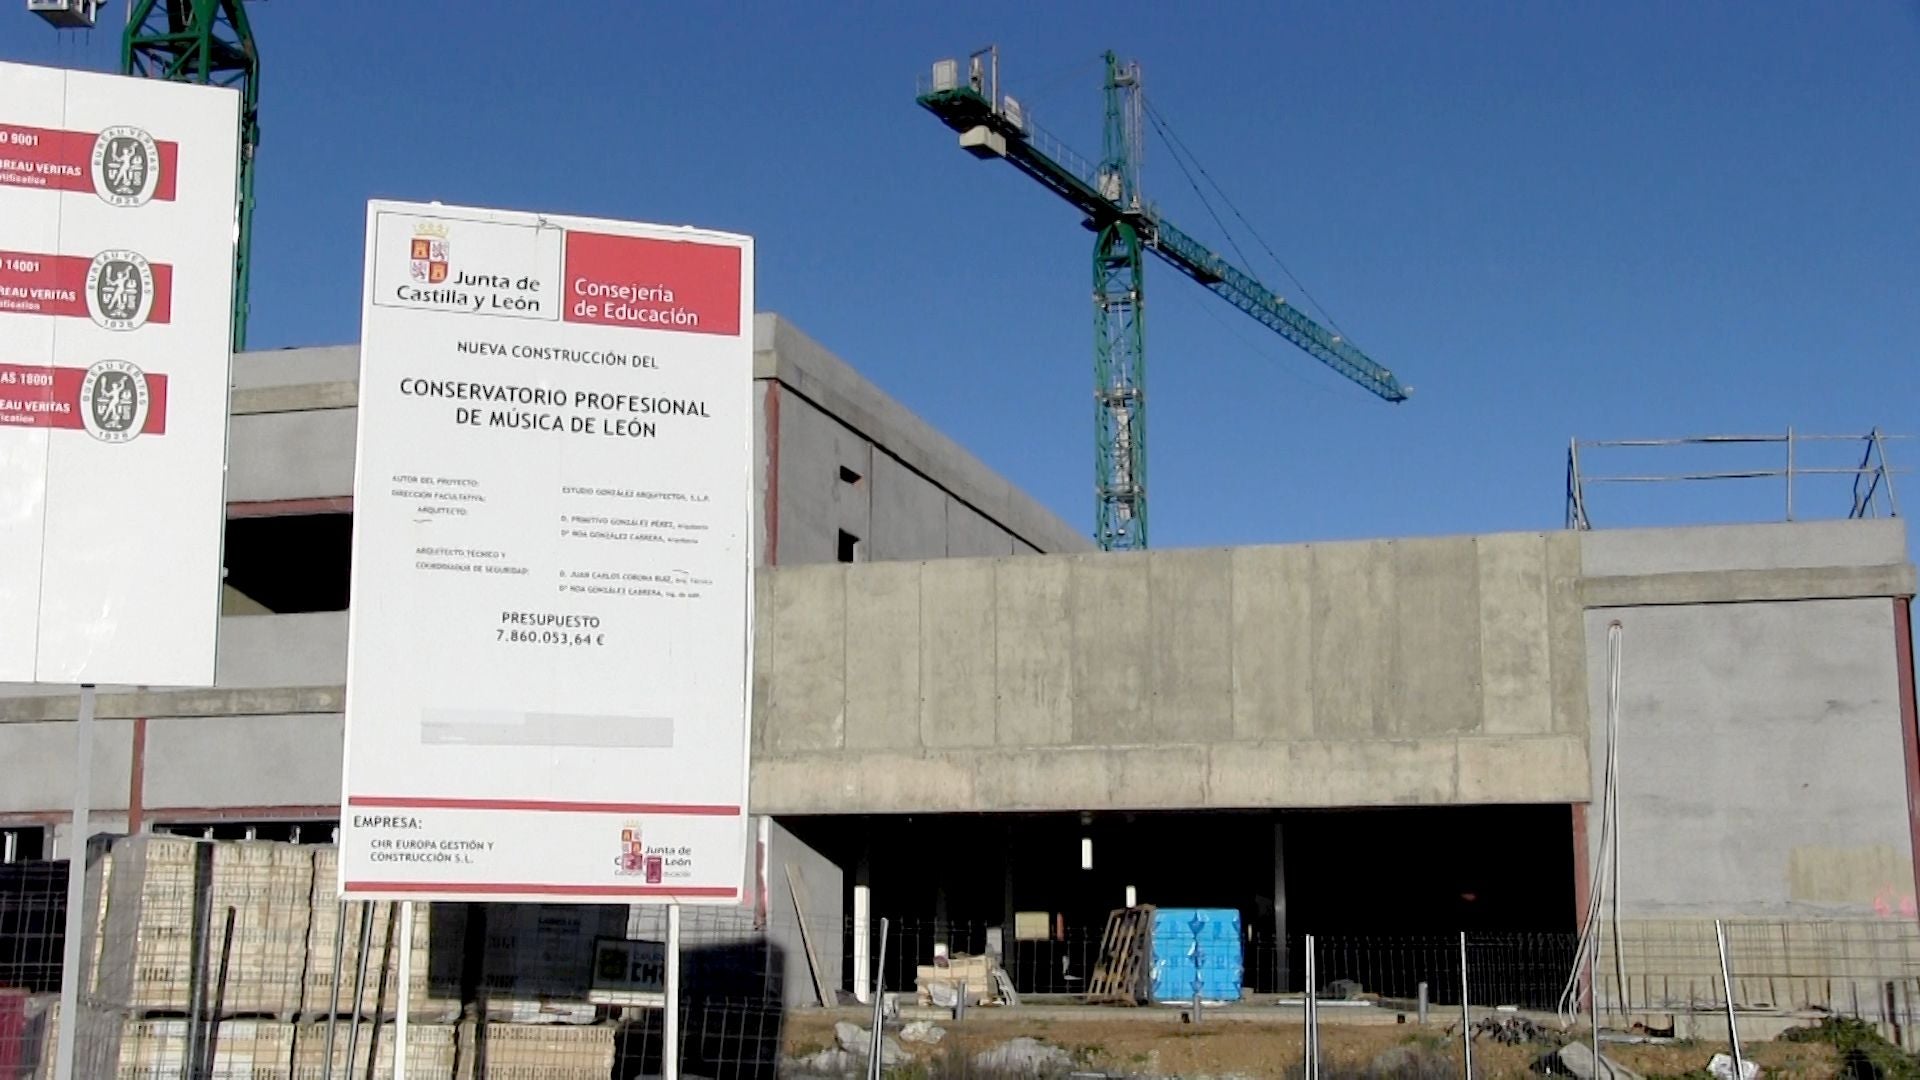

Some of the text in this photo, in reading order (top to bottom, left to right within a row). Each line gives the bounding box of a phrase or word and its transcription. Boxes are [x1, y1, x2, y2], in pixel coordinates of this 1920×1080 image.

[11, 133, 39, 146] 9001
[35, 162, 82, 176] VERITAS
[6, 259, 40, 272] 14001
[453, 270, 541, 292] Junta de
[30, 289, 76, 302] VERITAS
[574, 277, 675, 304] Consejería
[397, 284, 541, 312] Castilla y León
[574, 300, 699, 327] de Educación
[457, 341, 659, 370] NUEVA CONSTRUCCIÓN DEL
[20, 373, 53, 386] 18001
[400, 377, 711, 418] CONSERVATORIO PROFESIONAL
[24, 400, 71, 414] VERITAS
[456, 406, 656, 438] DE MÚSICA DE LEÓN
[391, 475, 418, 484] AUTOR
[420, 477, 435, 485] DEL
[562, 486, 594, 495] ESTUDIO
[473, 564, 482, 572] DE
[591, 571, 620, 580] CARLOS
[502, 611, 600, 628] PRESUPUESTO
[496, 629, 605, 646] 7.860.053,64 €
[353, 815, 423, 830] EMPRESA:
[371, 839, 494, 851] CHR EUROPA GESTIÓN Y
[645, 845, 691, 855] Junta de
[370, 851, 451, 863] CONSTRUCCIÓN
[665, 857, 691, 866] León
